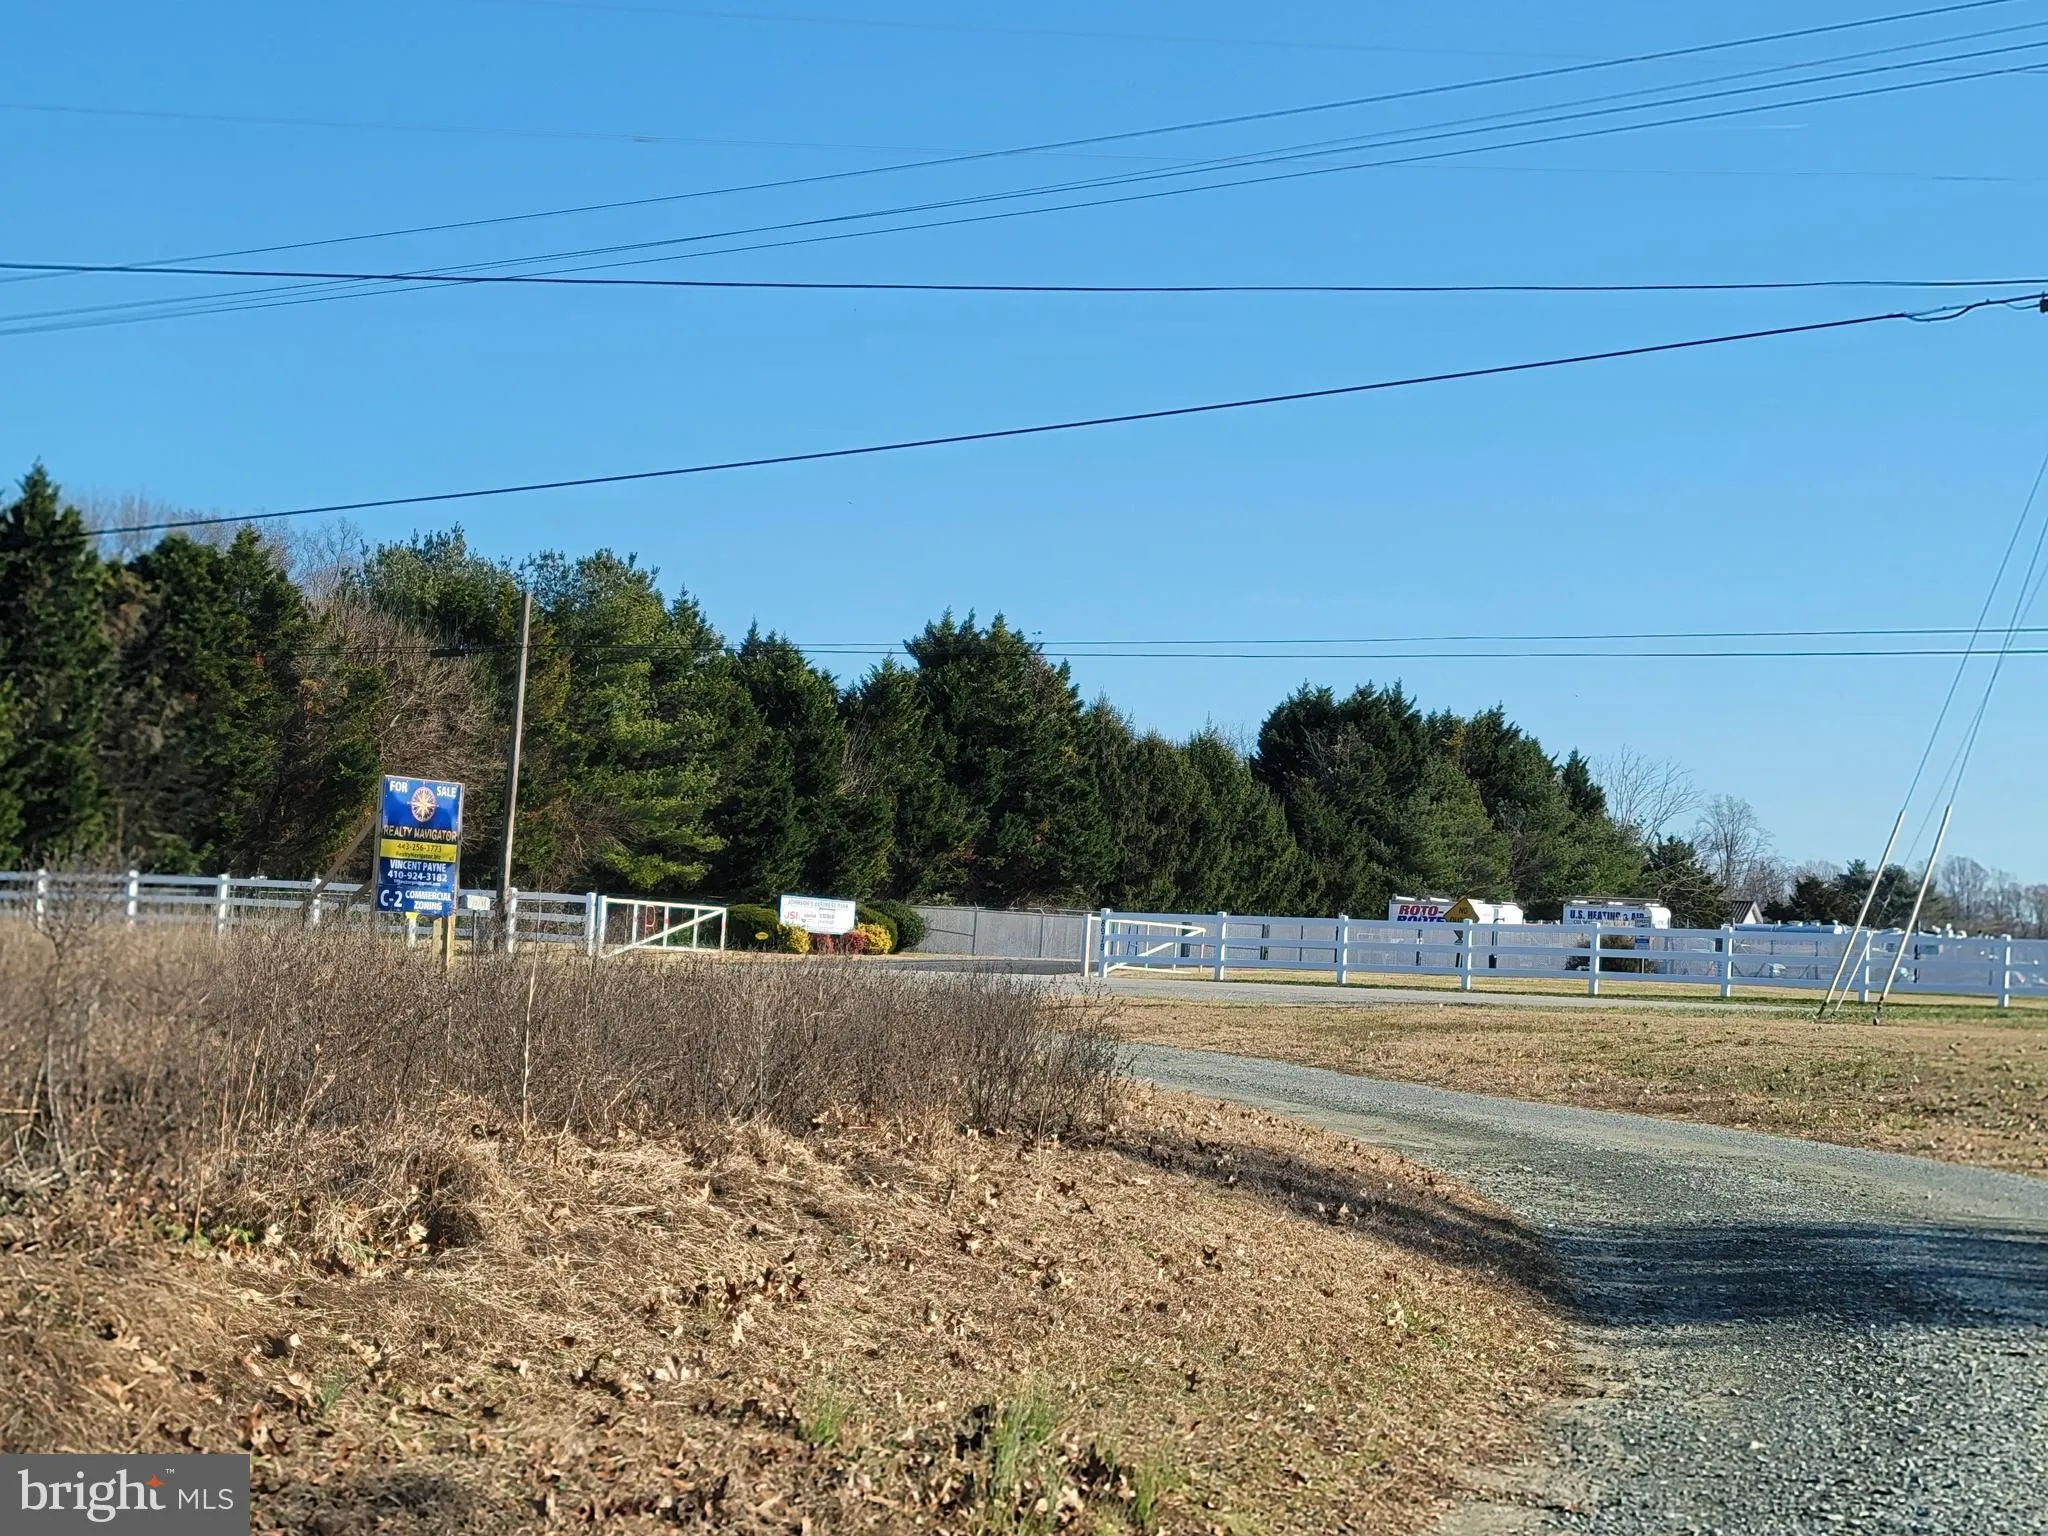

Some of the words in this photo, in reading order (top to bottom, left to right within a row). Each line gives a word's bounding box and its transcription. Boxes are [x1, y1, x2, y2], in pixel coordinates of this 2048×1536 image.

[389, 781, 408, 792] FOR
[436, 785, 457, 797] SALE
[383, 825, 412, 837] REALTY
[414, 828, 457, 841] NAVIGATOR
[389, 859, 421, 871] VINCENT
[422, 862, 447, 872] PAYNE
[387, 870, 448, 882] 410-924-3182
[380, 889, 403, 907] C-2
[405, 890, 452, 901] COMMERCIAL
[413, 900, 442, 910] ZONING
[1398, 905, 1444, 916] ROTO-
[1570, 910, 1585, 919] U.S.
[1587, 910, 1621, 920] HEATING
